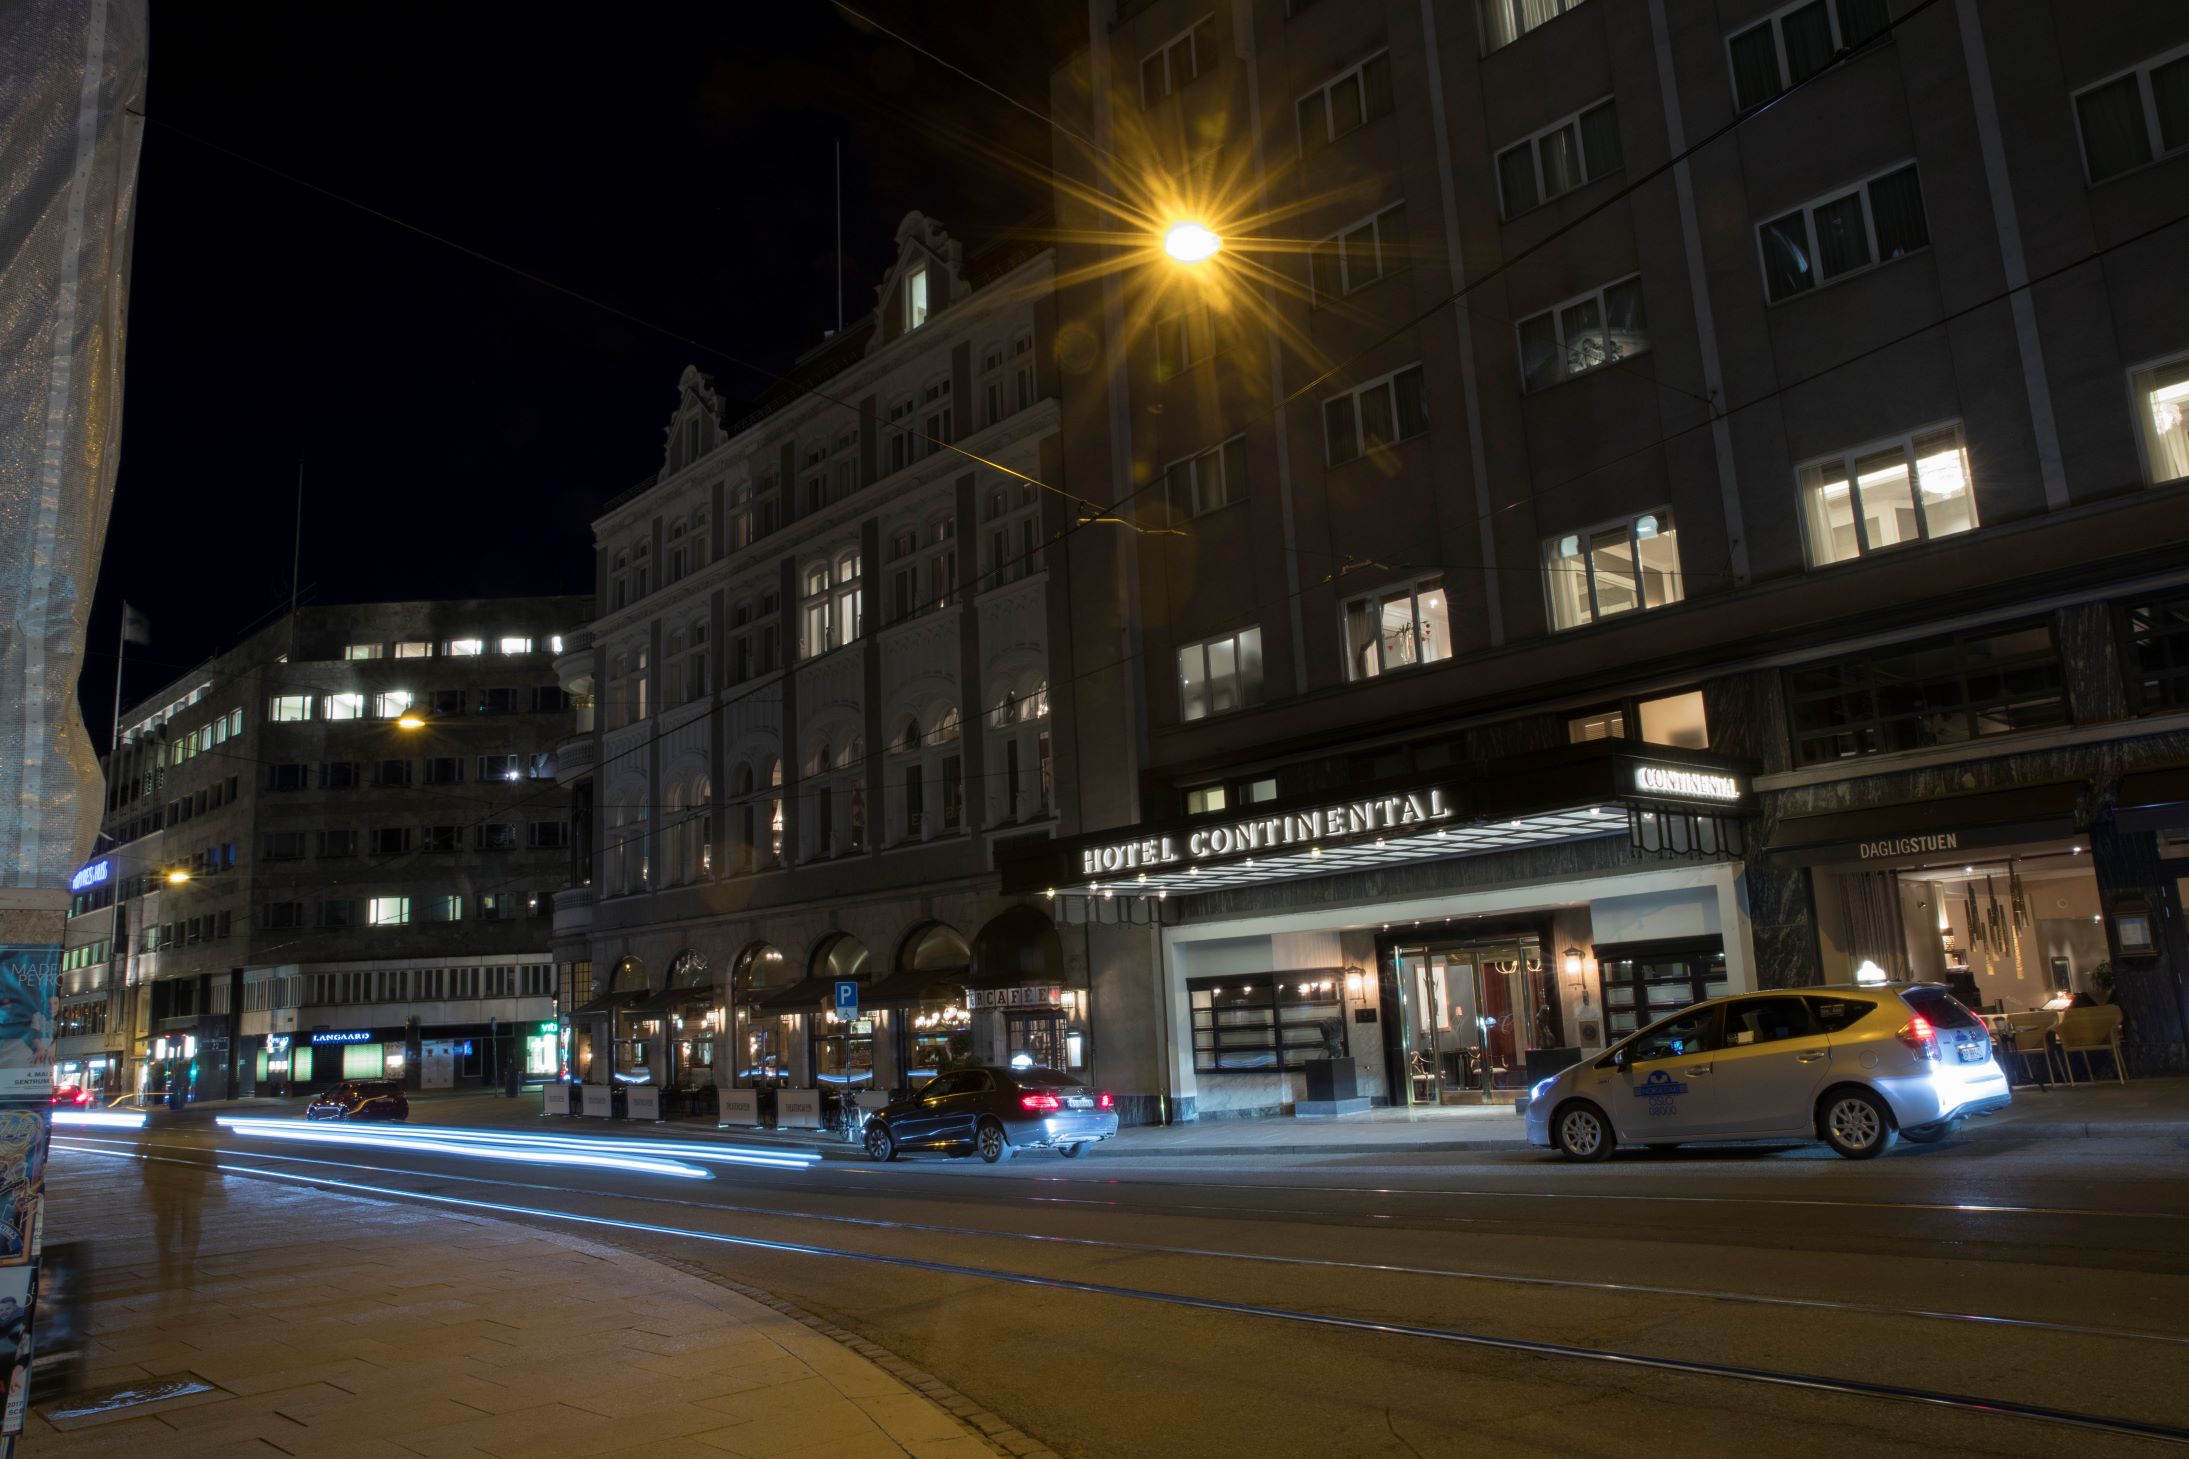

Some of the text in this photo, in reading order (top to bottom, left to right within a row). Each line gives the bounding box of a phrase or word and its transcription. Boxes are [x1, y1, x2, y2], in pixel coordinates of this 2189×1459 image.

[1637, 766, 1740, 799] CONTINENTAL
[1083, 790, 1451, 874] HOTEL CONTINENTAL
[1860, 833, 1958, 859] DAGLIGSTUEN
[841, 985, 852, 1005] P
[313, 1031, 370, 1042] LANGAARD
